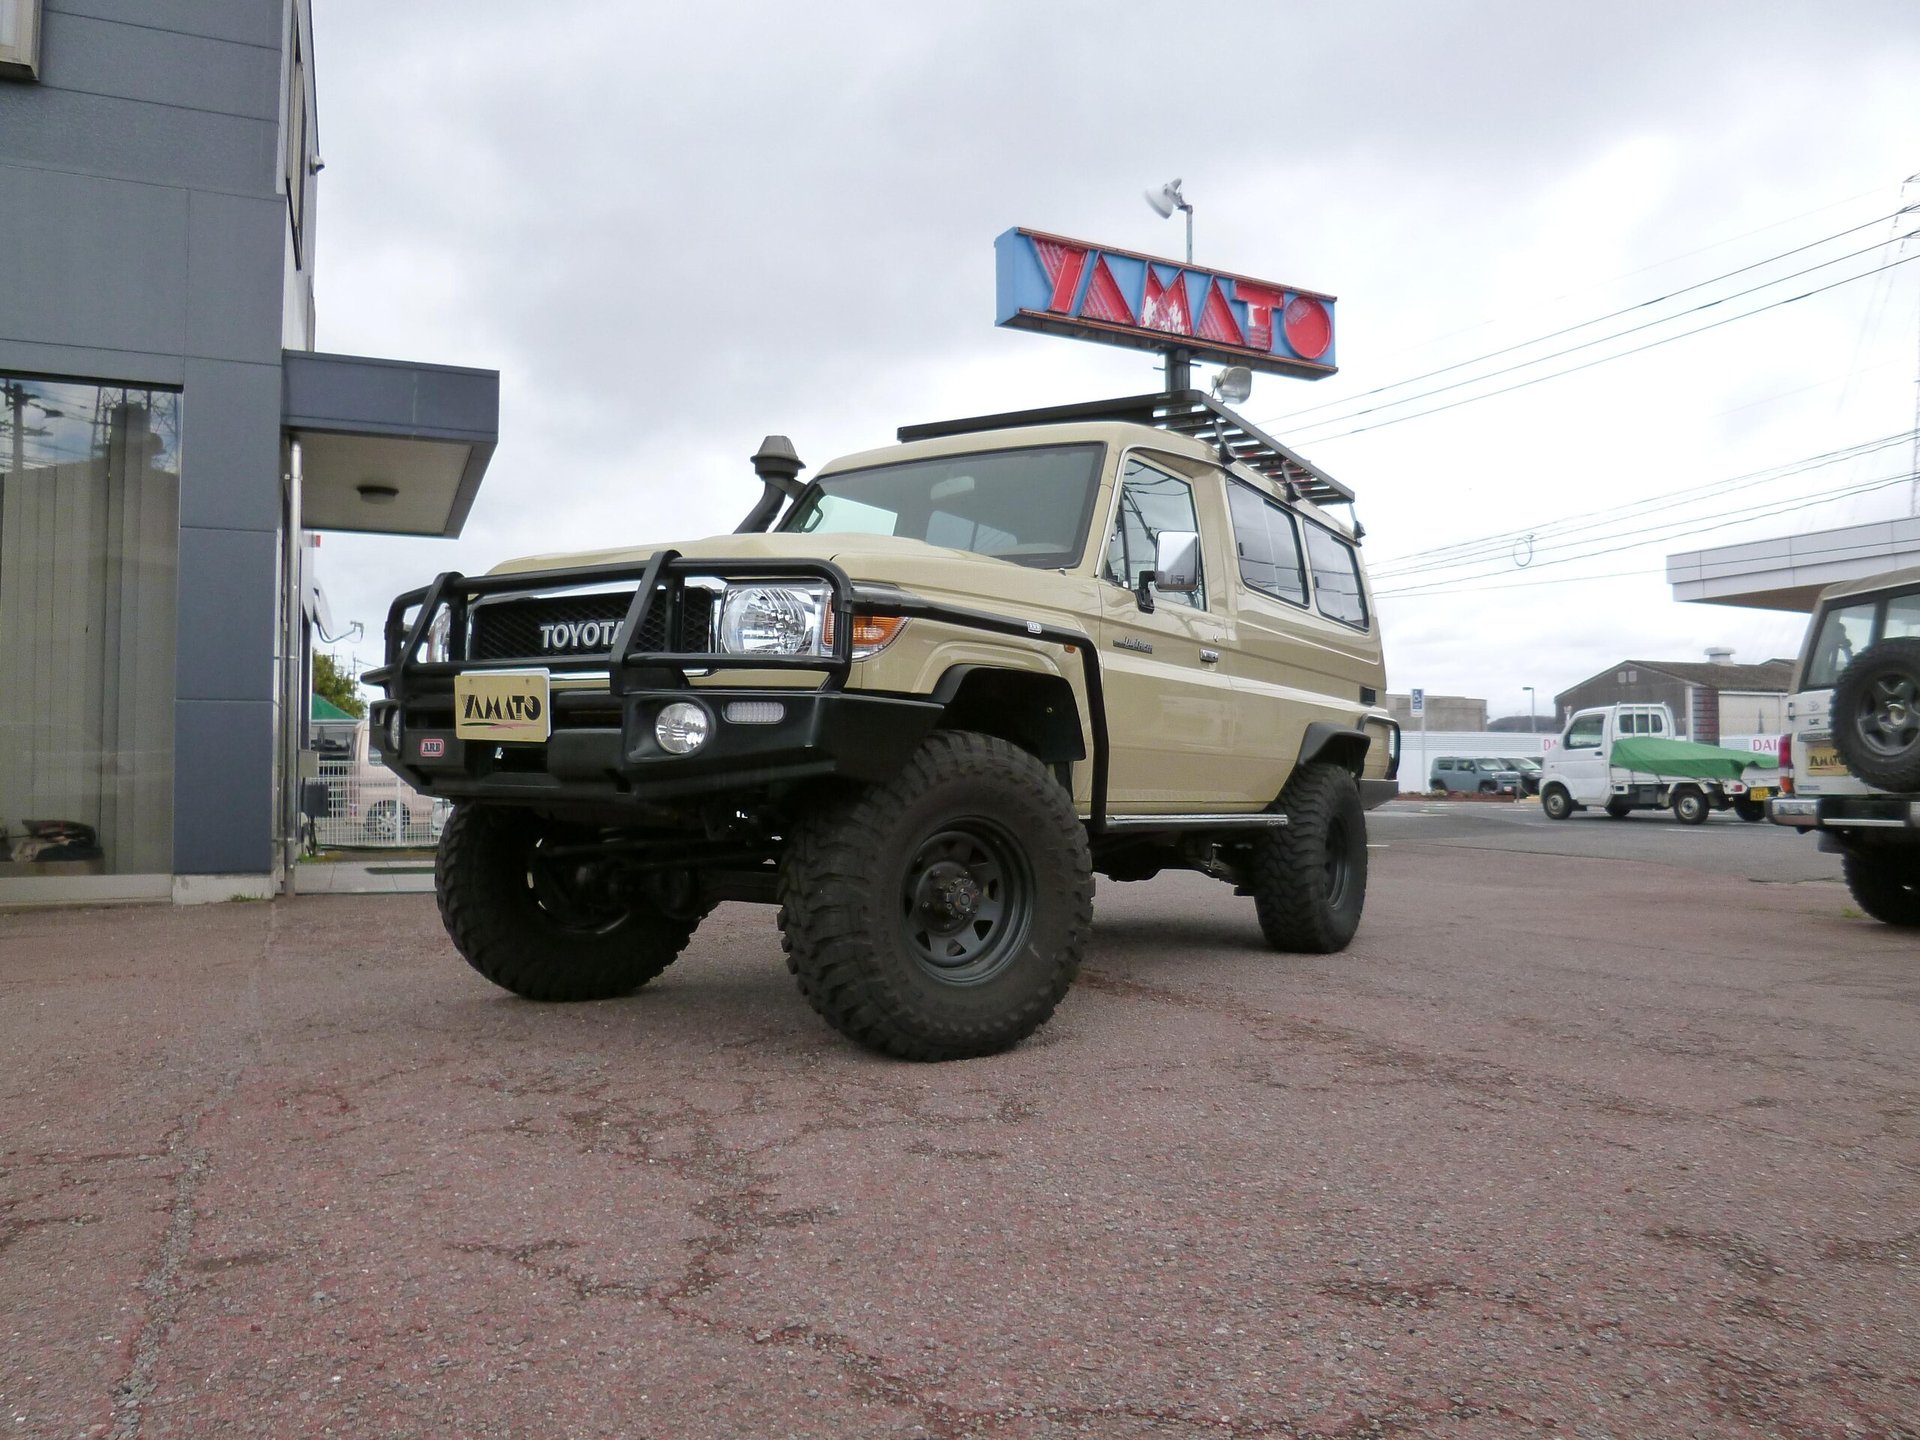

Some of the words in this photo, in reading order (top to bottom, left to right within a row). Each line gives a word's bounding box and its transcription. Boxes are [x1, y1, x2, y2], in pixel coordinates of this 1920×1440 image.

[1031, 236, 1332, 360] YAMATO
[460, 694, 542, 721] YAMATO
[423, 742, 441, 753] ARB
